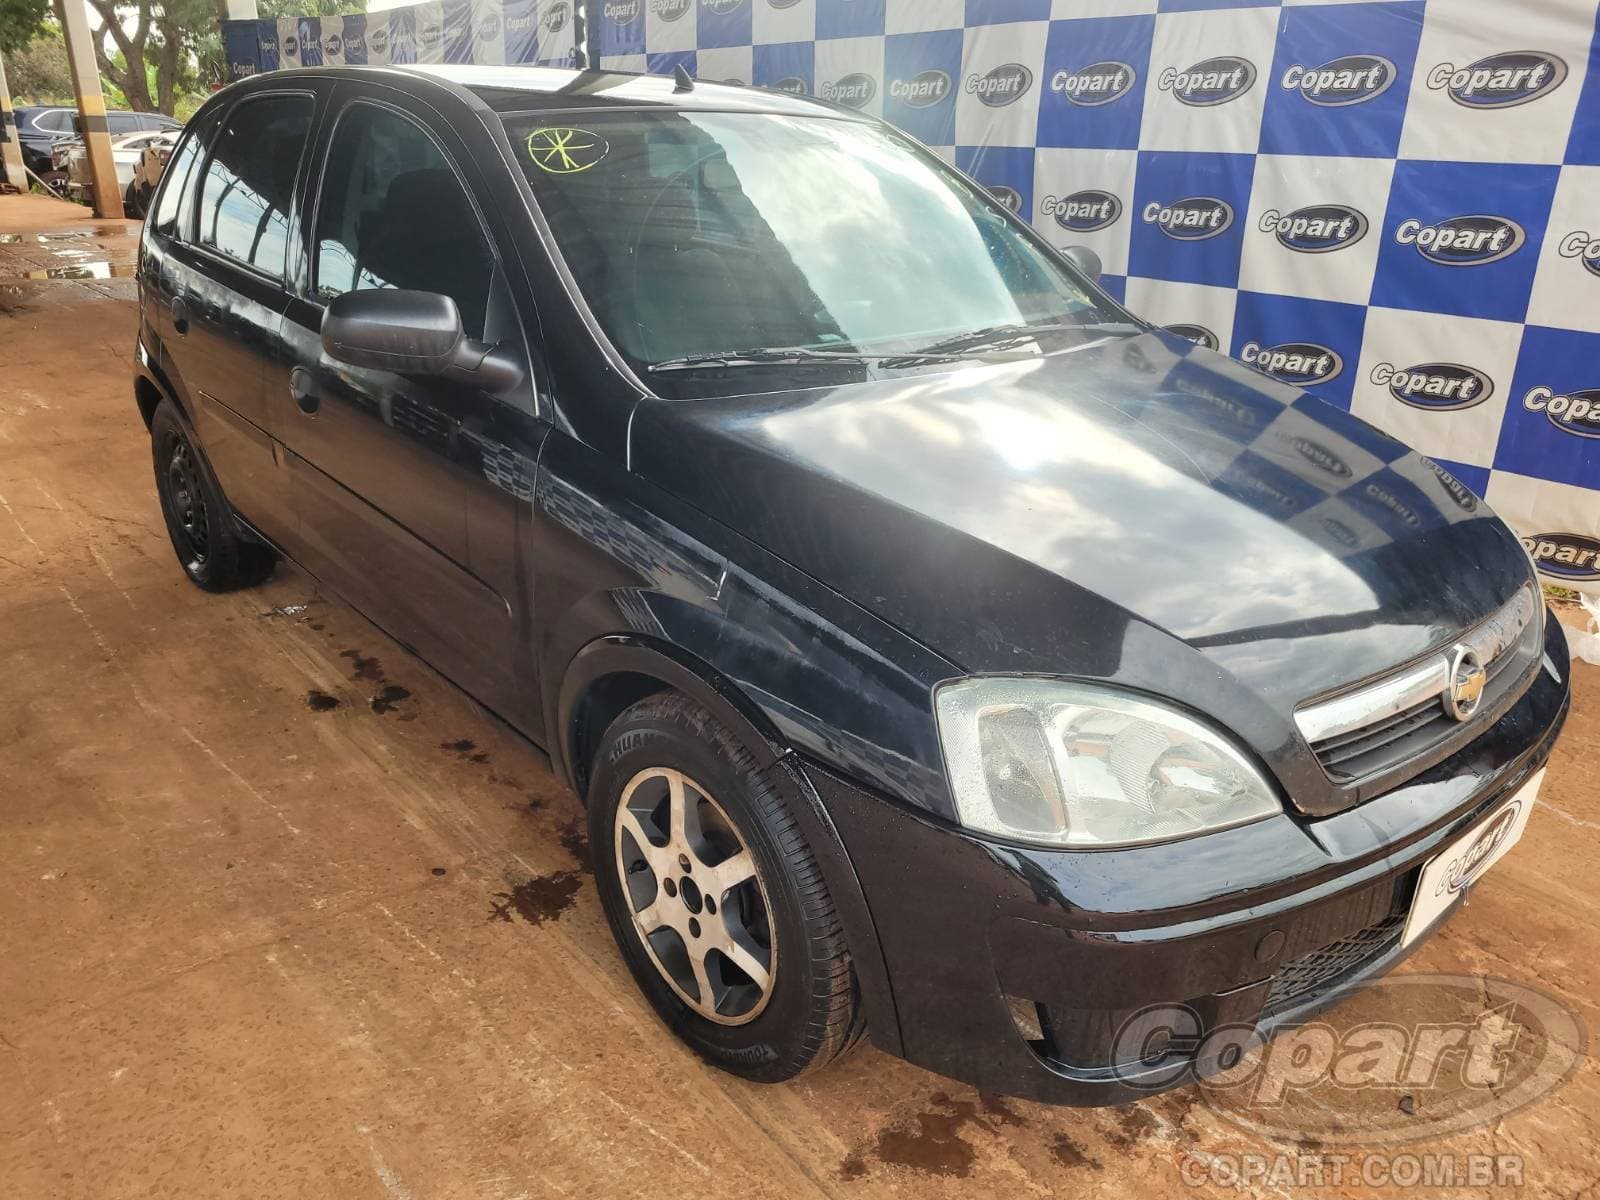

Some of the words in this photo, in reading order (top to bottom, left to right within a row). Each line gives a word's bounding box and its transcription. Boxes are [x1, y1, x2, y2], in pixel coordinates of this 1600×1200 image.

[604, 3, 636, 19] Copart
[233, 62, 256, 77] Copart
[965, 70, 1022, 95] Copart
[1051, 65, 1125, 97] Copart
[1158, 63, 1244, 97] Copart
[1281, 63, 1384, 97] Copart
[1427, 59, 1551, 96] Copart
[821, 81, 868, 103] Copart
[890, 79, 944, 99] Copart
[1041, 194, 1114, 221] Copart
[1143, 202, 1228, 231] Copart
[1258, 209, 1355, 239] Copart
[1394, 218, 1511, 253] Copart
[1240, 341, 1332, 377] Copart
[1370, 362, 1479, 402] Copart
[1435, 806, 1515, 896] Copart
